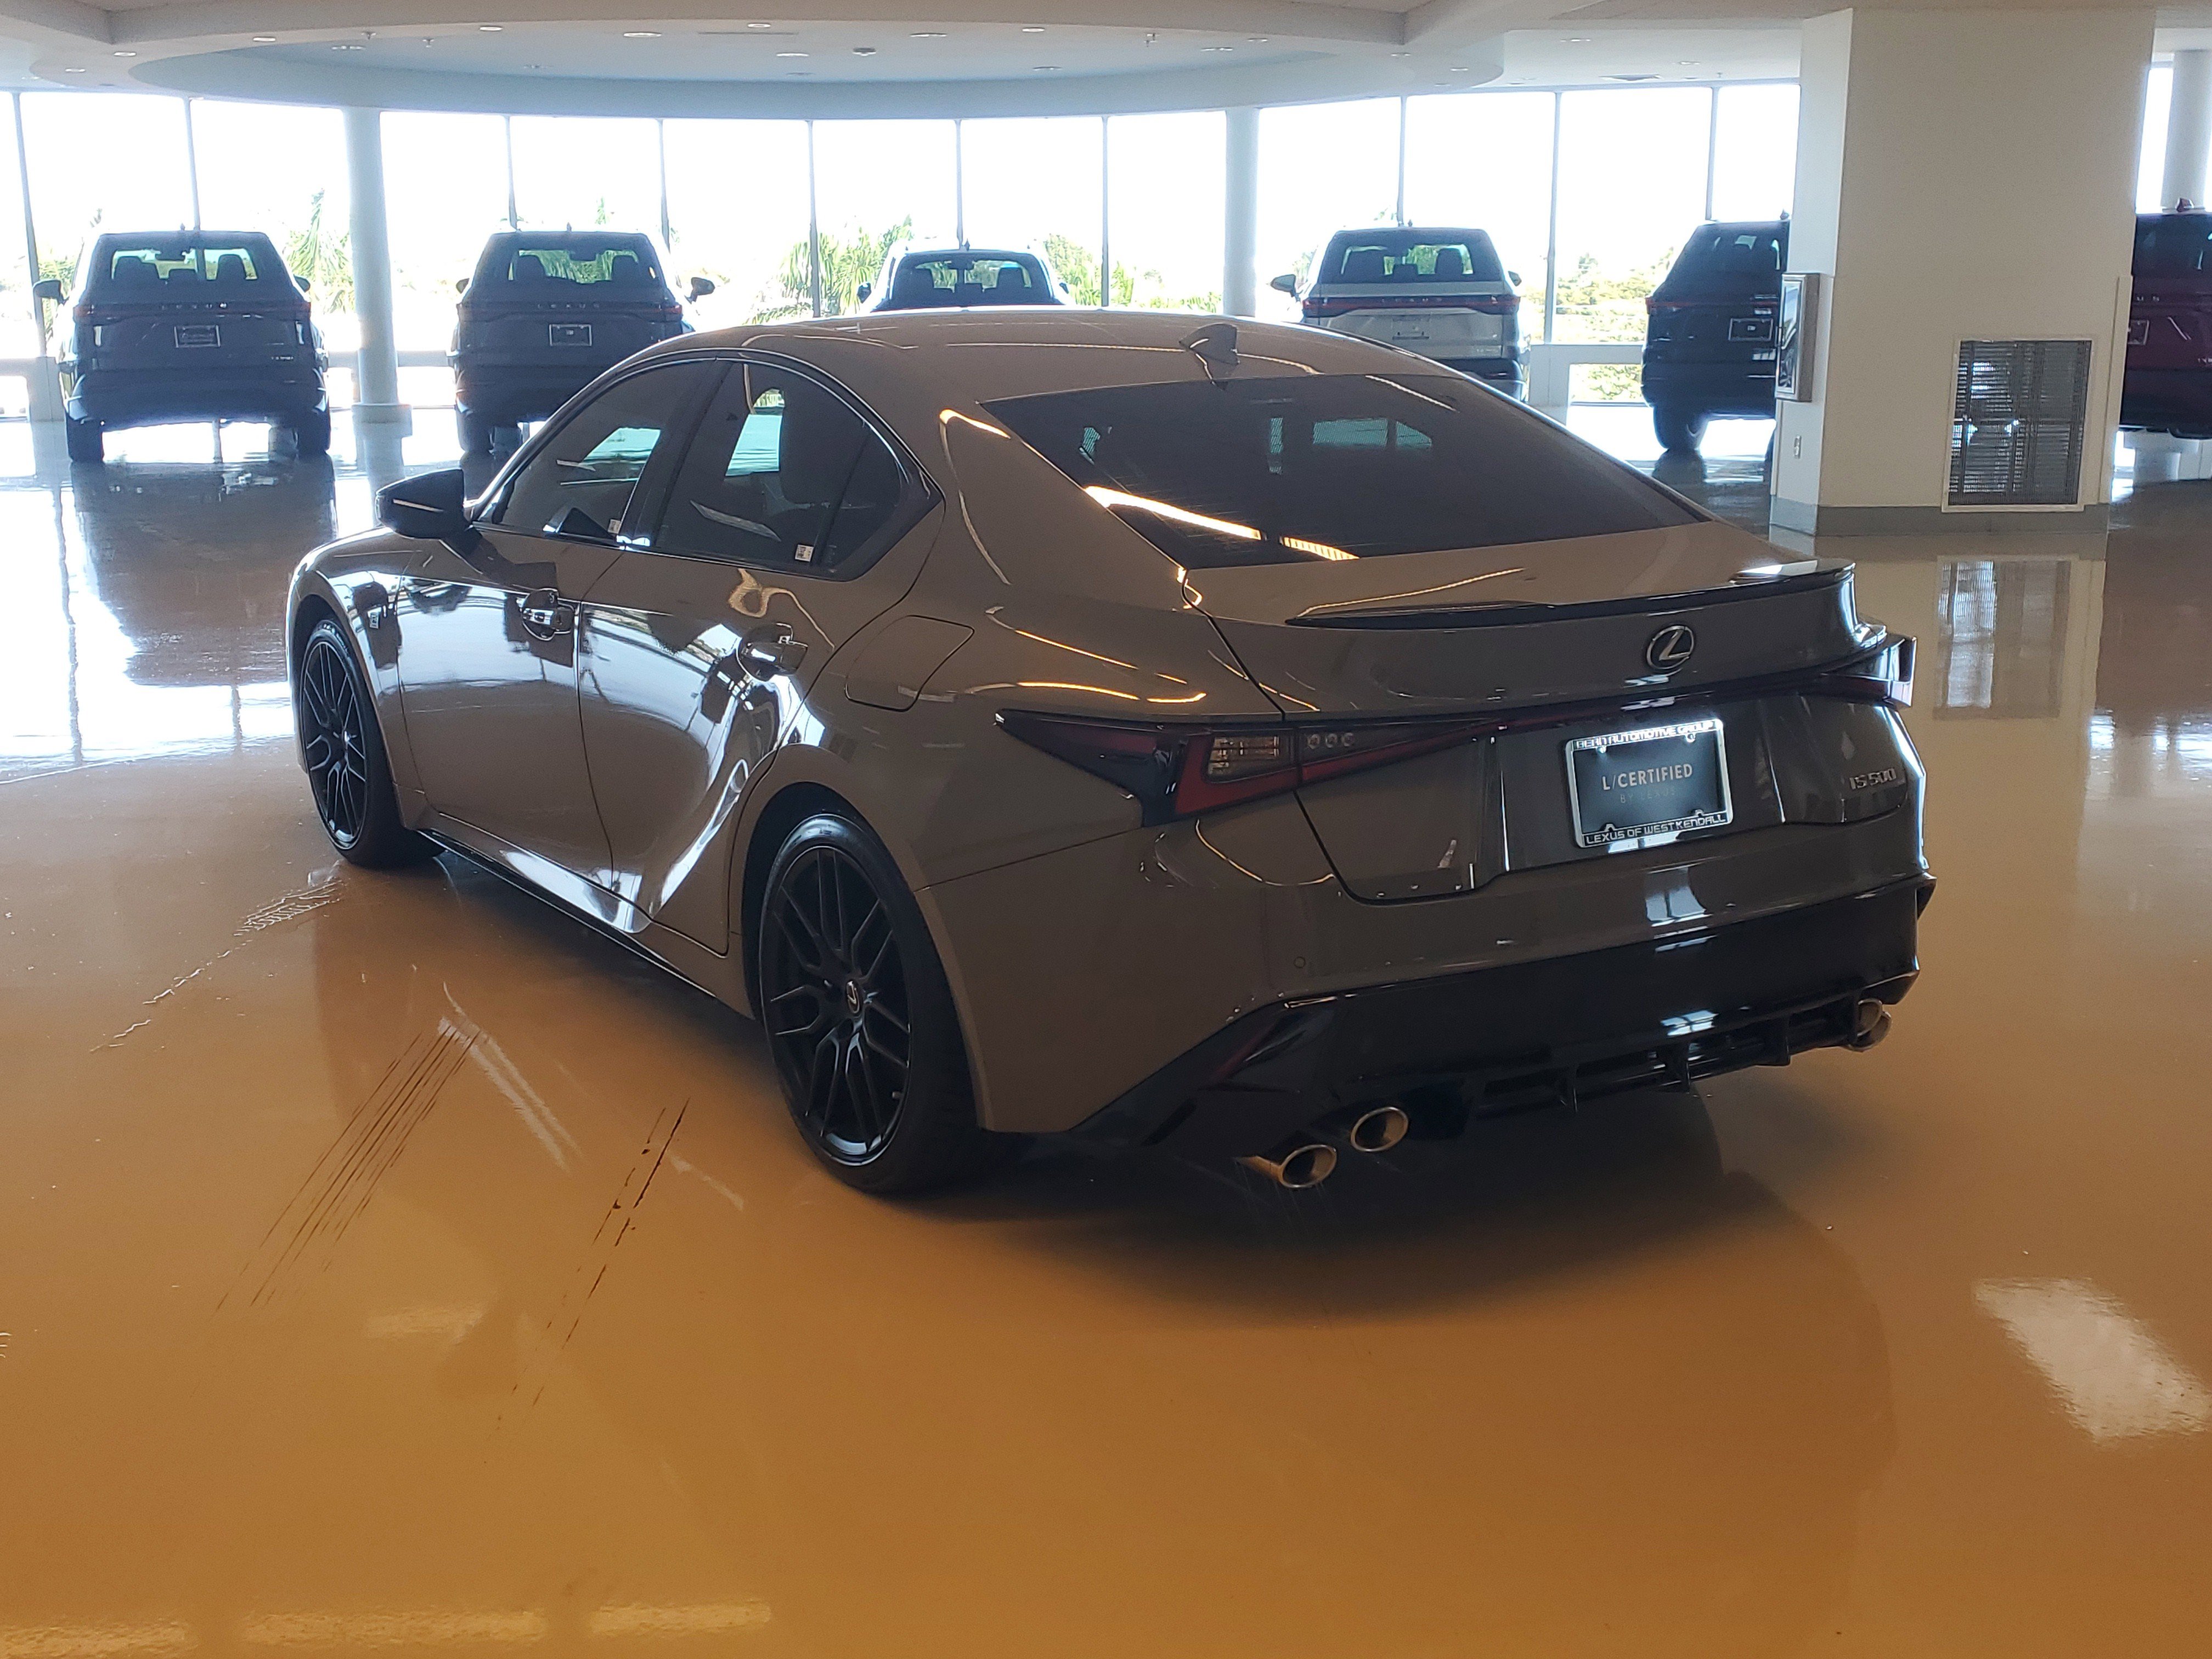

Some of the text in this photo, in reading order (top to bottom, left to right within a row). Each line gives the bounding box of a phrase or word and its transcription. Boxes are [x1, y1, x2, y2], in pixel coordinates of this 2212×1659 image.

[1609, 727, 1677, 745] AUTOMOTIVE
[1867, 768, 1897, 787] 500
[1586, 814, 1726, 844] LEXUS OF WEST KENDALL
